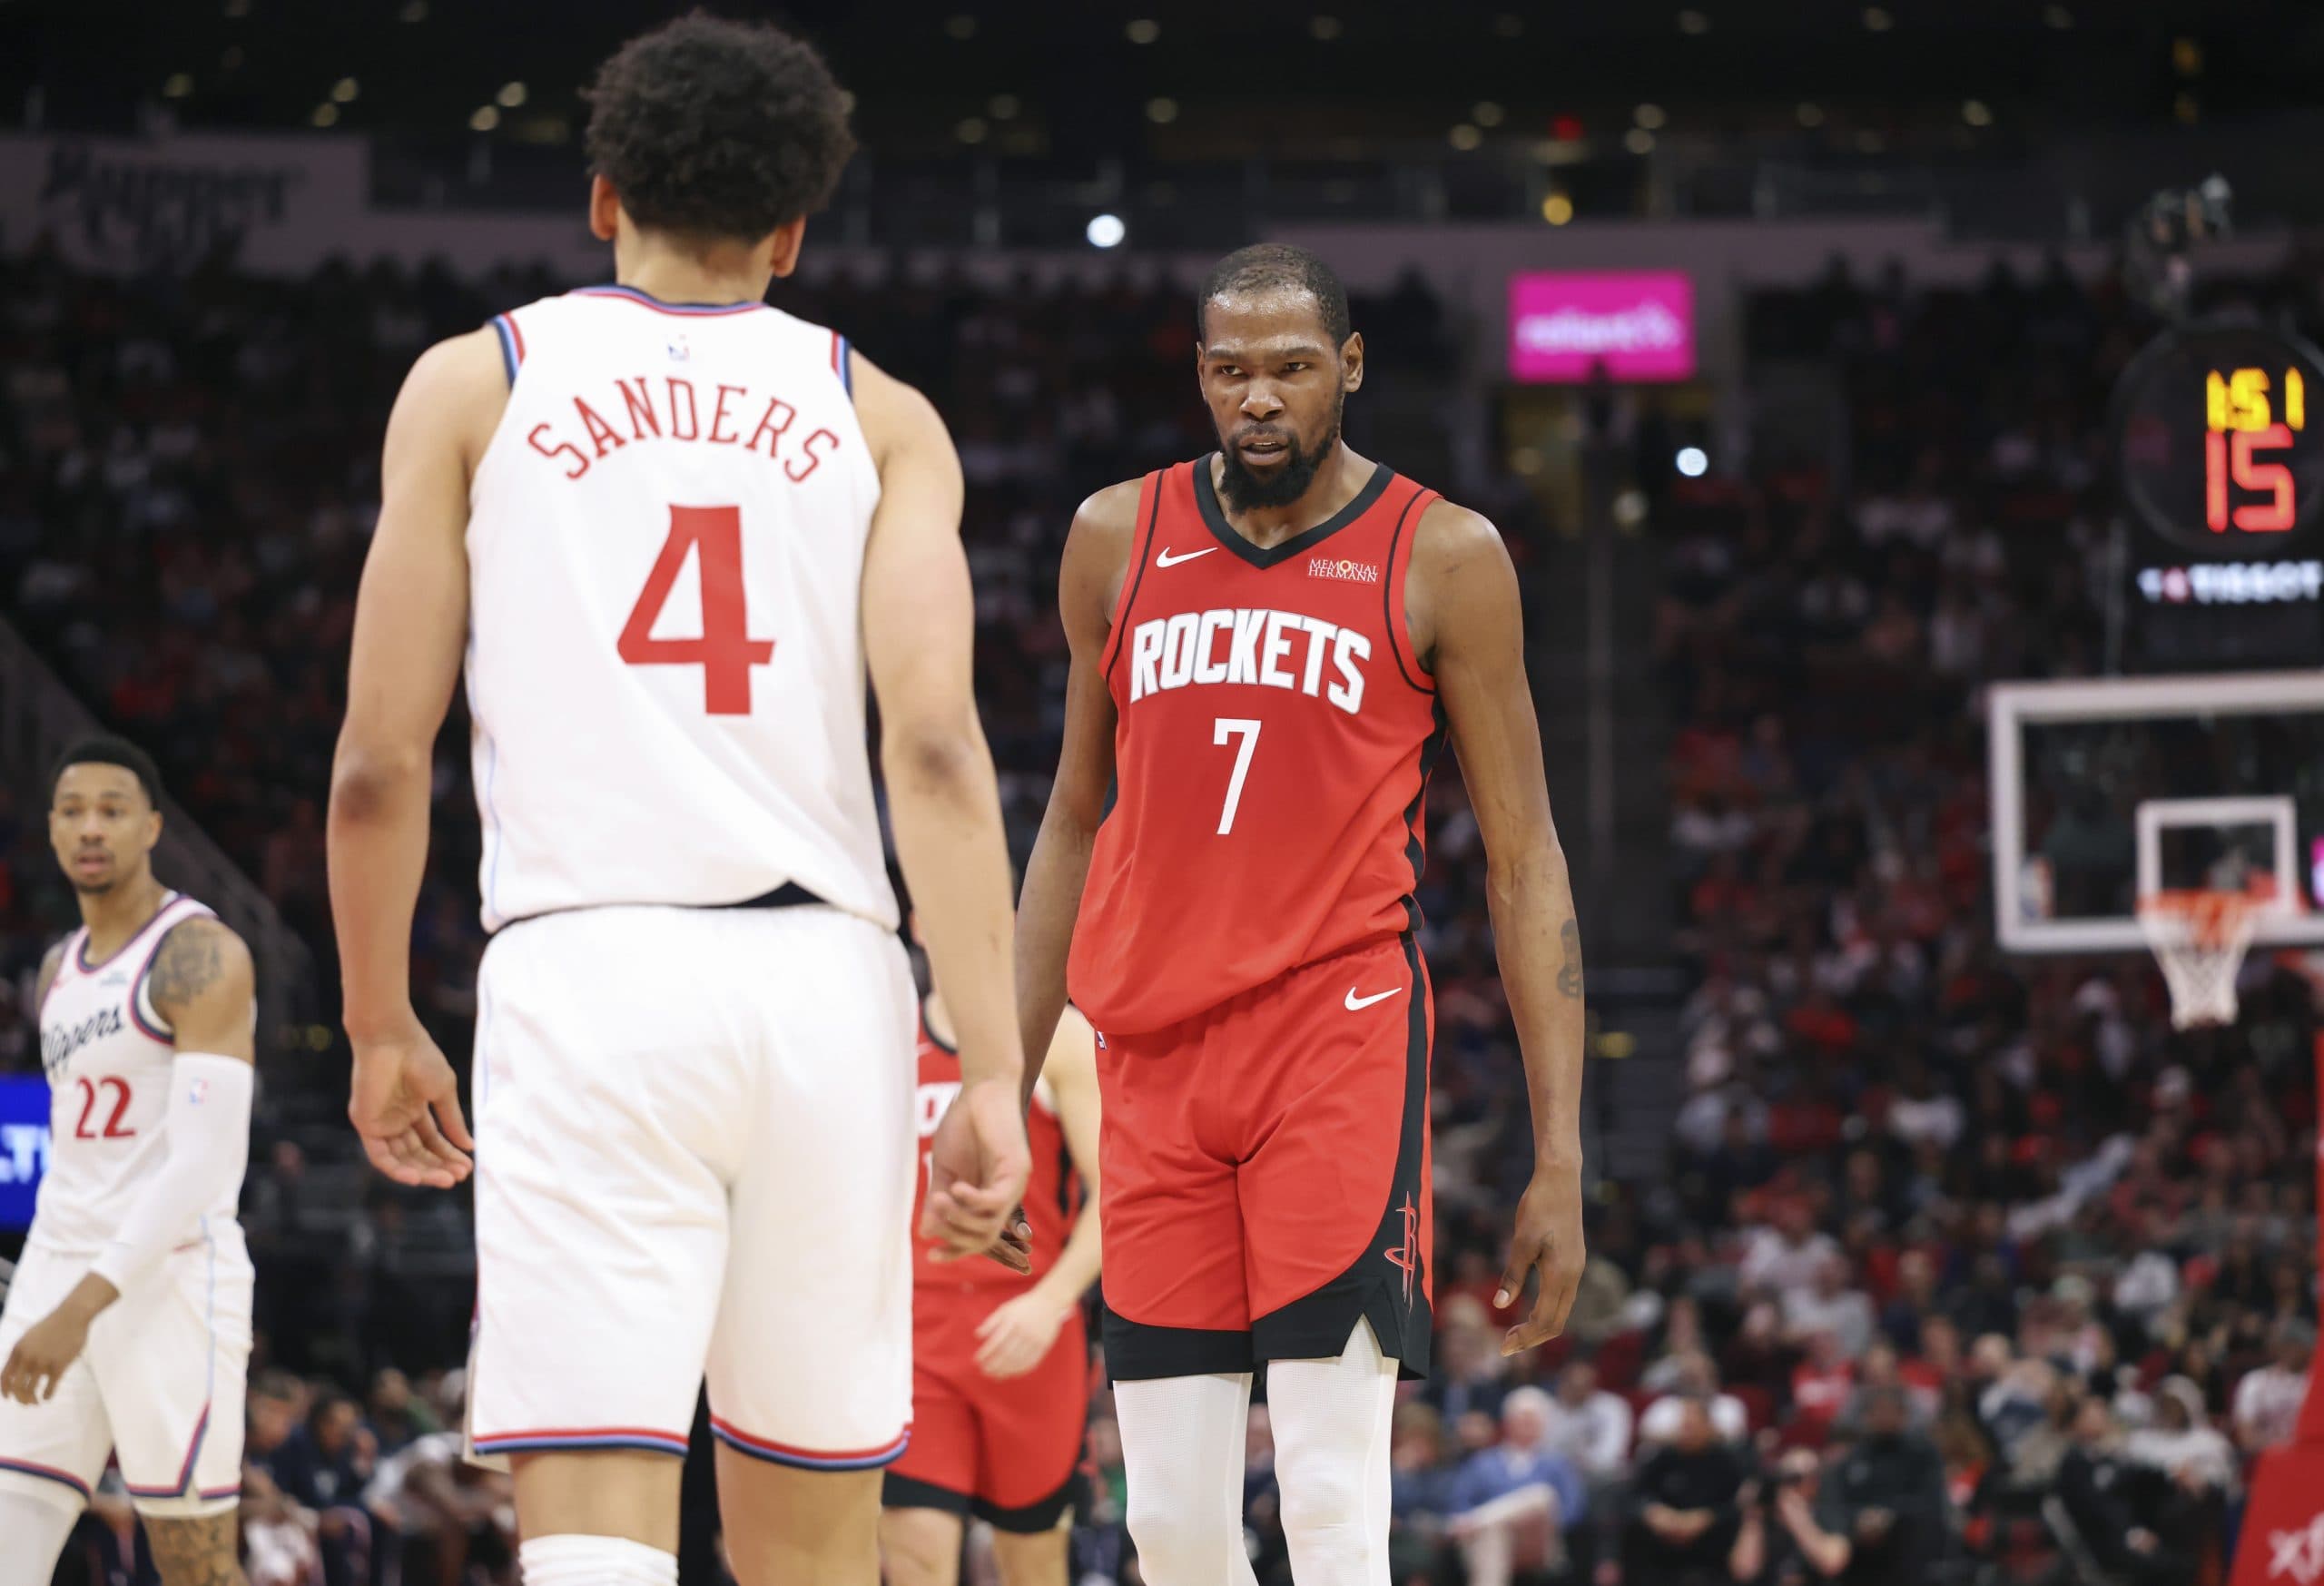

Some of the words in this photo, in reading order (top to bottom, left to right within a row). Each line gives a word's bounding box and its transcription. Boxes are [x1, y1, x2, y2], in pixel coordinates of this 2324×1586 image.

[527, 376, 841, 483] SANDERS
[2206, 422, 2297, 534] 15
[616, 503, 776, 716] 4
[1308, 558, 1378, 576] MEMORIAL
[1308, 566, 1377, 583] HERMANN
[1129, 607, 1372, 715] ROCKETS
[1213, 717, 1262, 835] 7
[75, 1076, 135, 1139] 22
